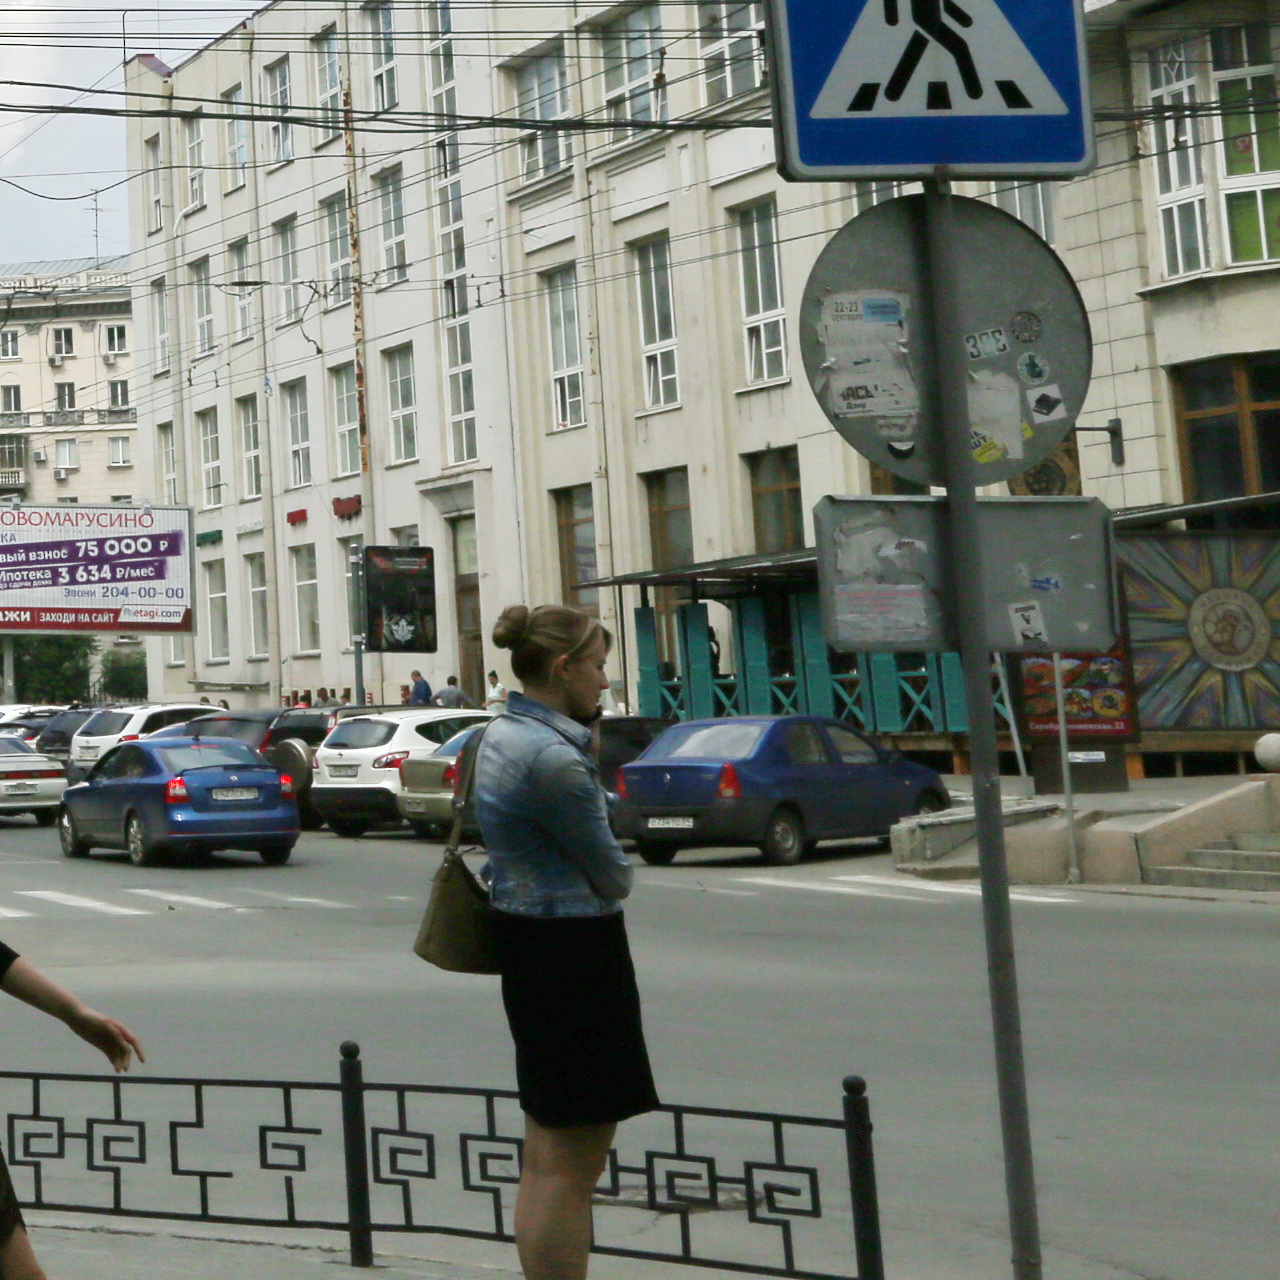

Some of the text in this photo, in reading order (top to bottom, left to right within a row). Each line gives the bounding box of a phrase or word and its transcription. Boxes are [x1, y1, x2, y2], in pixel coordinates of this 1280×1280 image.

[29, 549, 68, 562] взнос
[75, 541, 98, 558] 75
[104, 537, 152, 556] 000
[58, 567, 69, 583] 3
[76, 564, 111, 582] 634
[64, 586, 184, 599] Звони 204-00-00
[40, 612, 75, 623] ЗАХОДИ
[78, 612, 90, 622] НА
[92, 610, 115, 623] САЙТ
[132, 608, 182, 622] etagi.com
